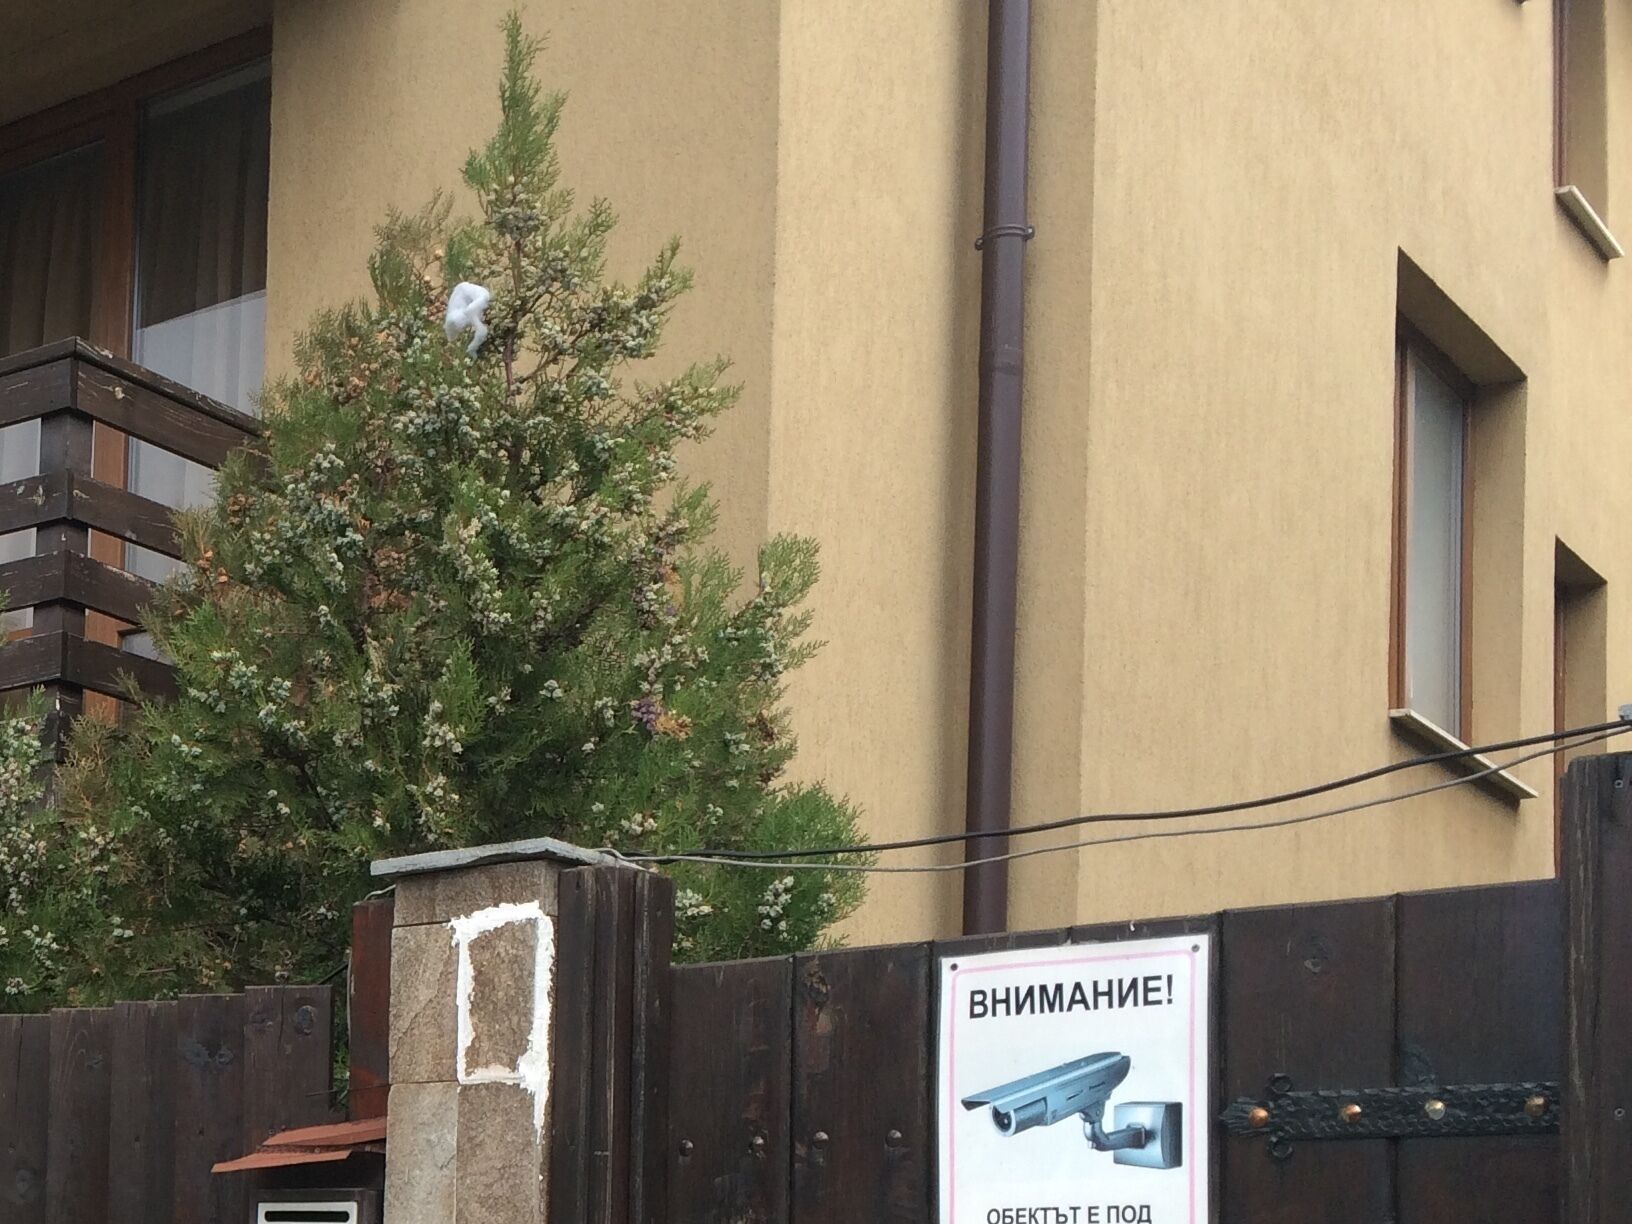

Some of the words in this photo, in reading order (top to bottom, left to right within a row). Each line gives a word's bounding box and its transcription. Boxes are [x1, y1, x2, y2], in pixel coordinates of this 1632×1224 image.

[969, 974, 1173, 1018] ВНИМАНИЕ!
[1087, 1205, 1099, 1224] Е
[1106, 1204, 1152, 1224] ПОД
